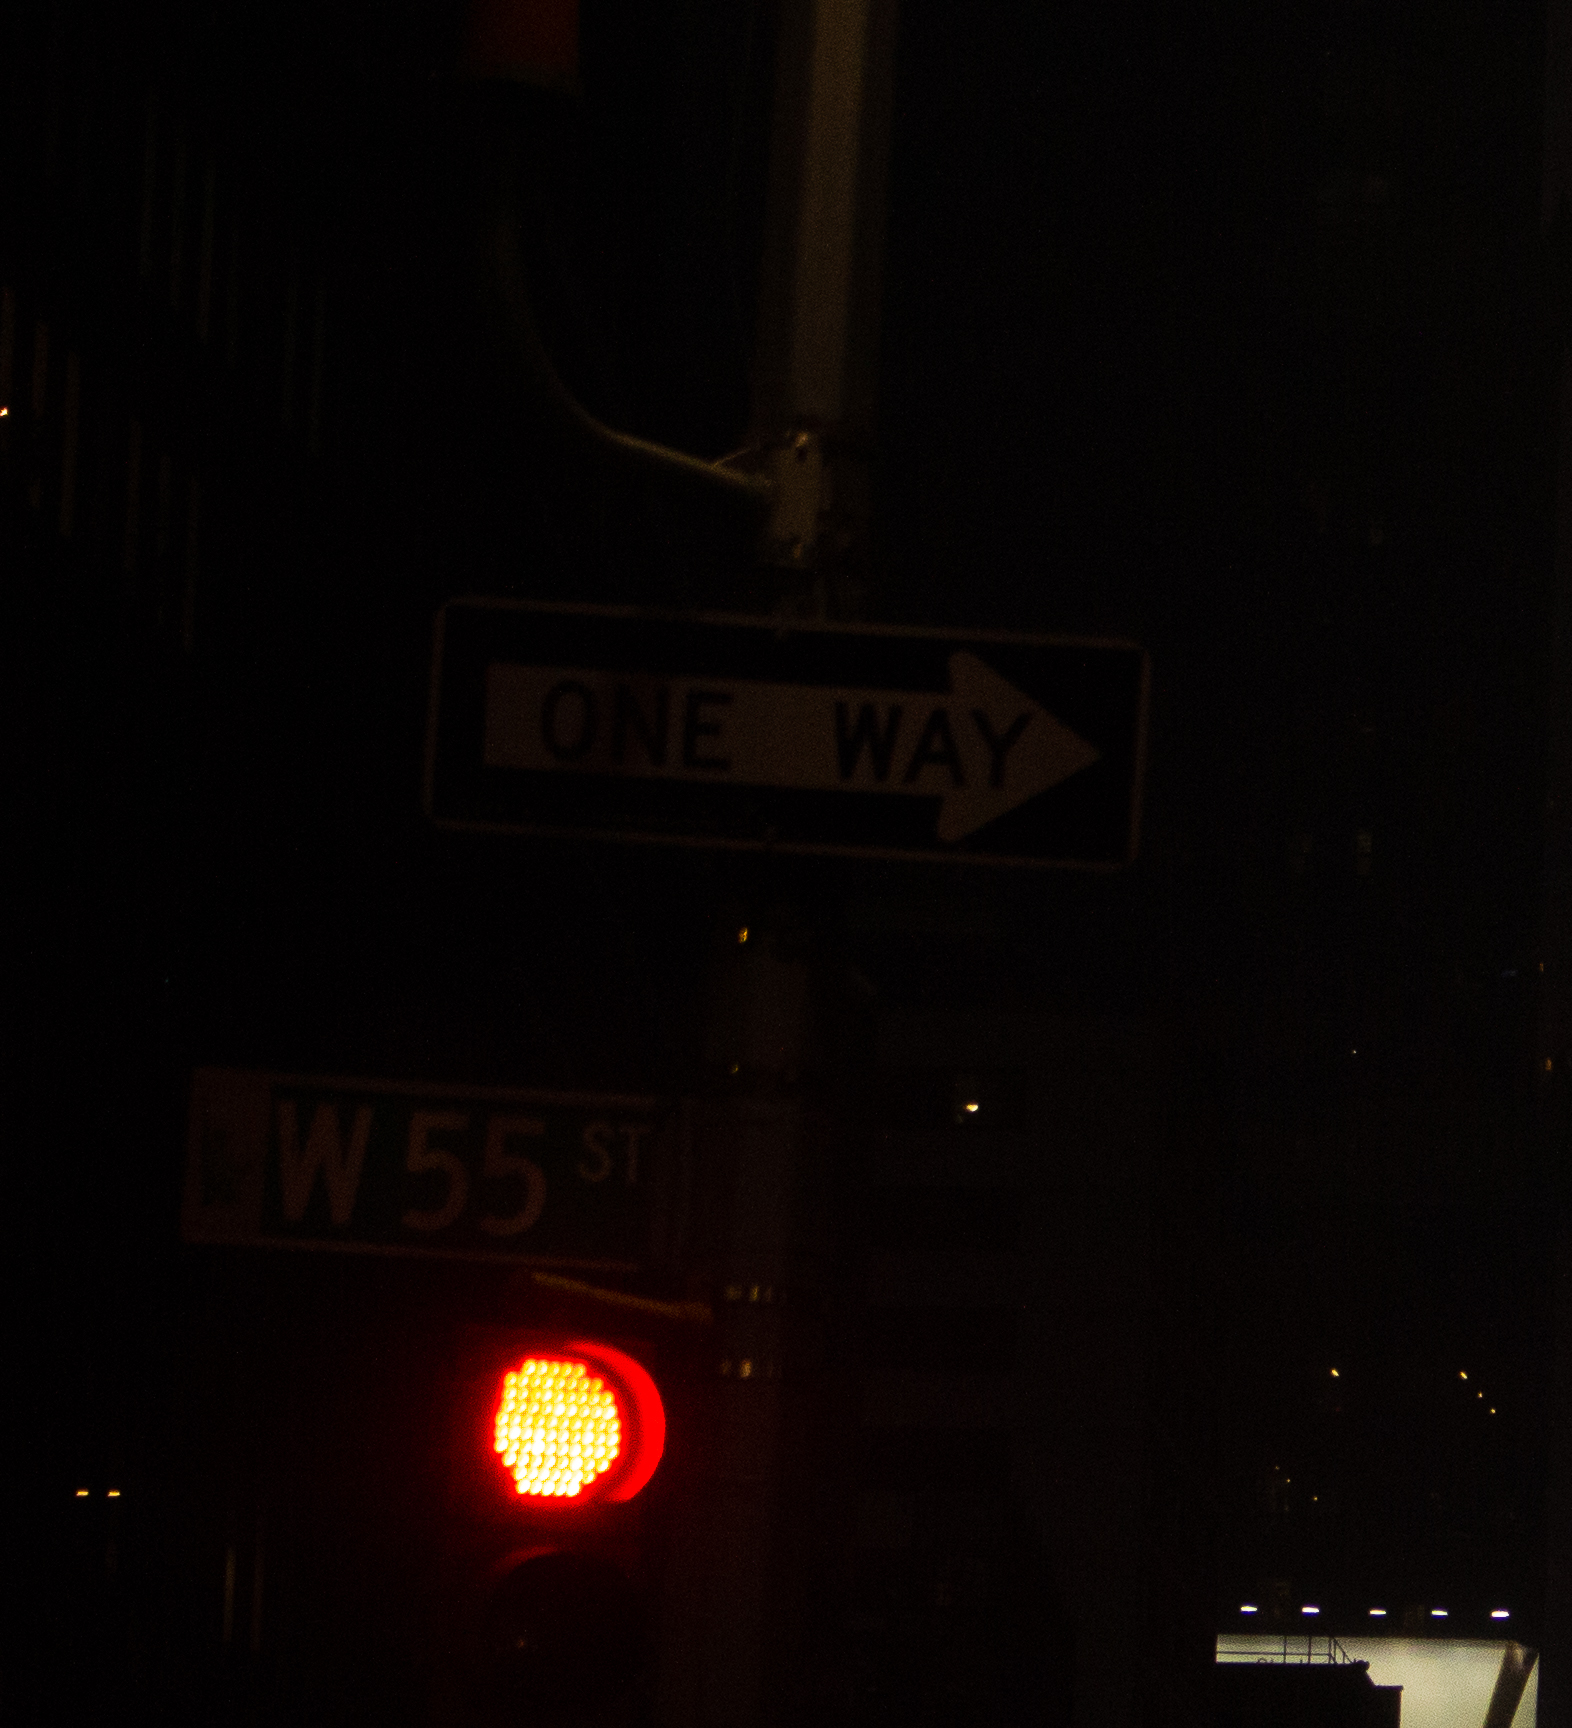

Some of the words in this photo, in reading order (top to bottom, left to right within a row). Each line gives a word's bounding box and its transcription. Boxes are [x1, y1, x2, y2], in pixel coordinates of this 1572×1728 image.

[541, 680, 734, 771] ONE
[835, 700, 1033, 790] WAY
[278, 1102, 374, 1227] W
[402, 1109, 547, 1236] 55
[577, 1119, 652, 1185] ST
